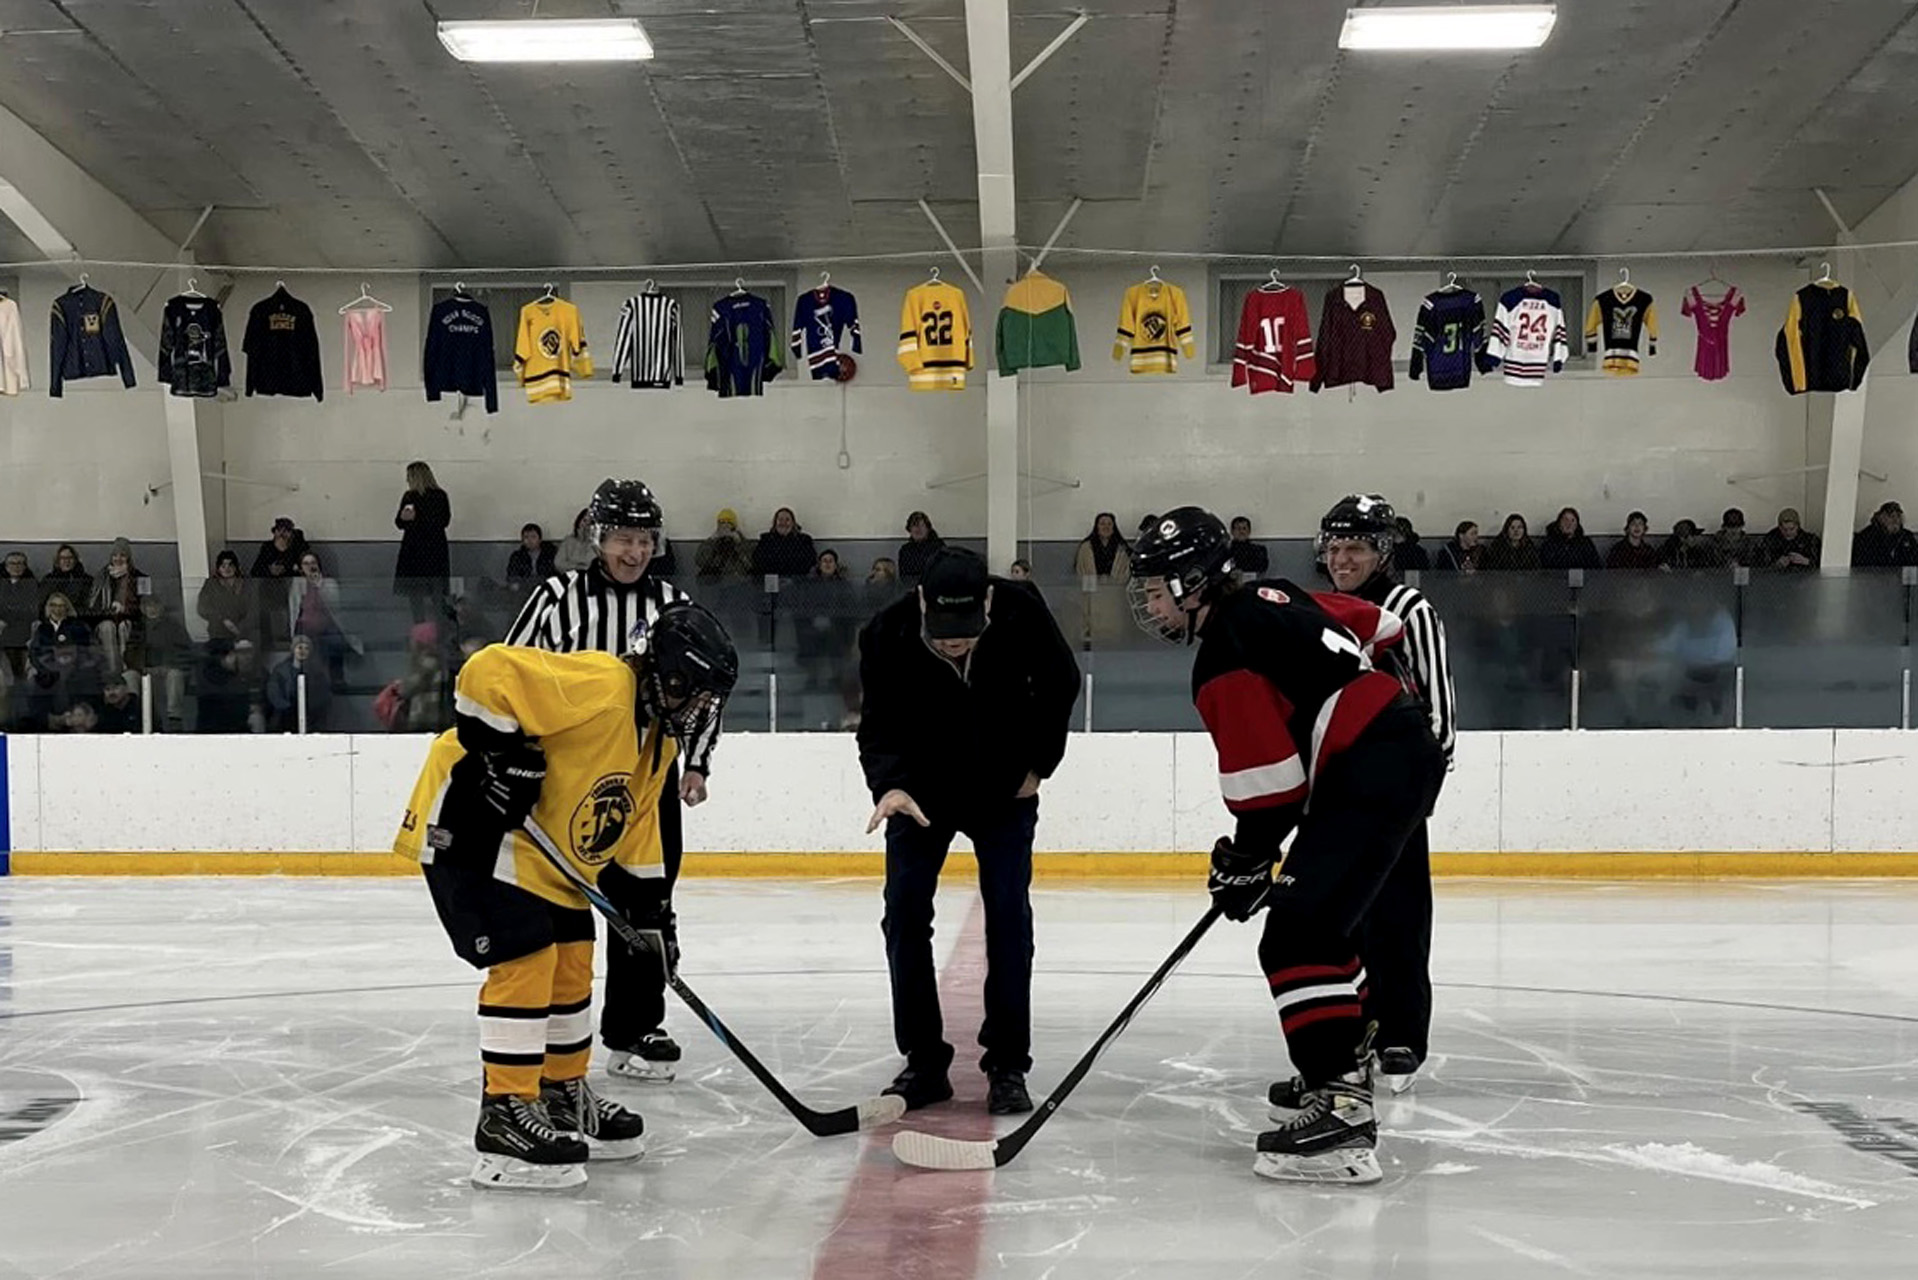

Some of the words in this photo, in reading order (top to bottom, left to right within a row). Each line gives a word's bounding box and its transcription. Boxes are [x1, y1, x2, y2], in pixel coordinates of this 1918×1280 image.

[448, 324, 479, 334] CHAMPS
[921, 310, 954, 346] 22
[1517, 312, 1548, 340] 24
